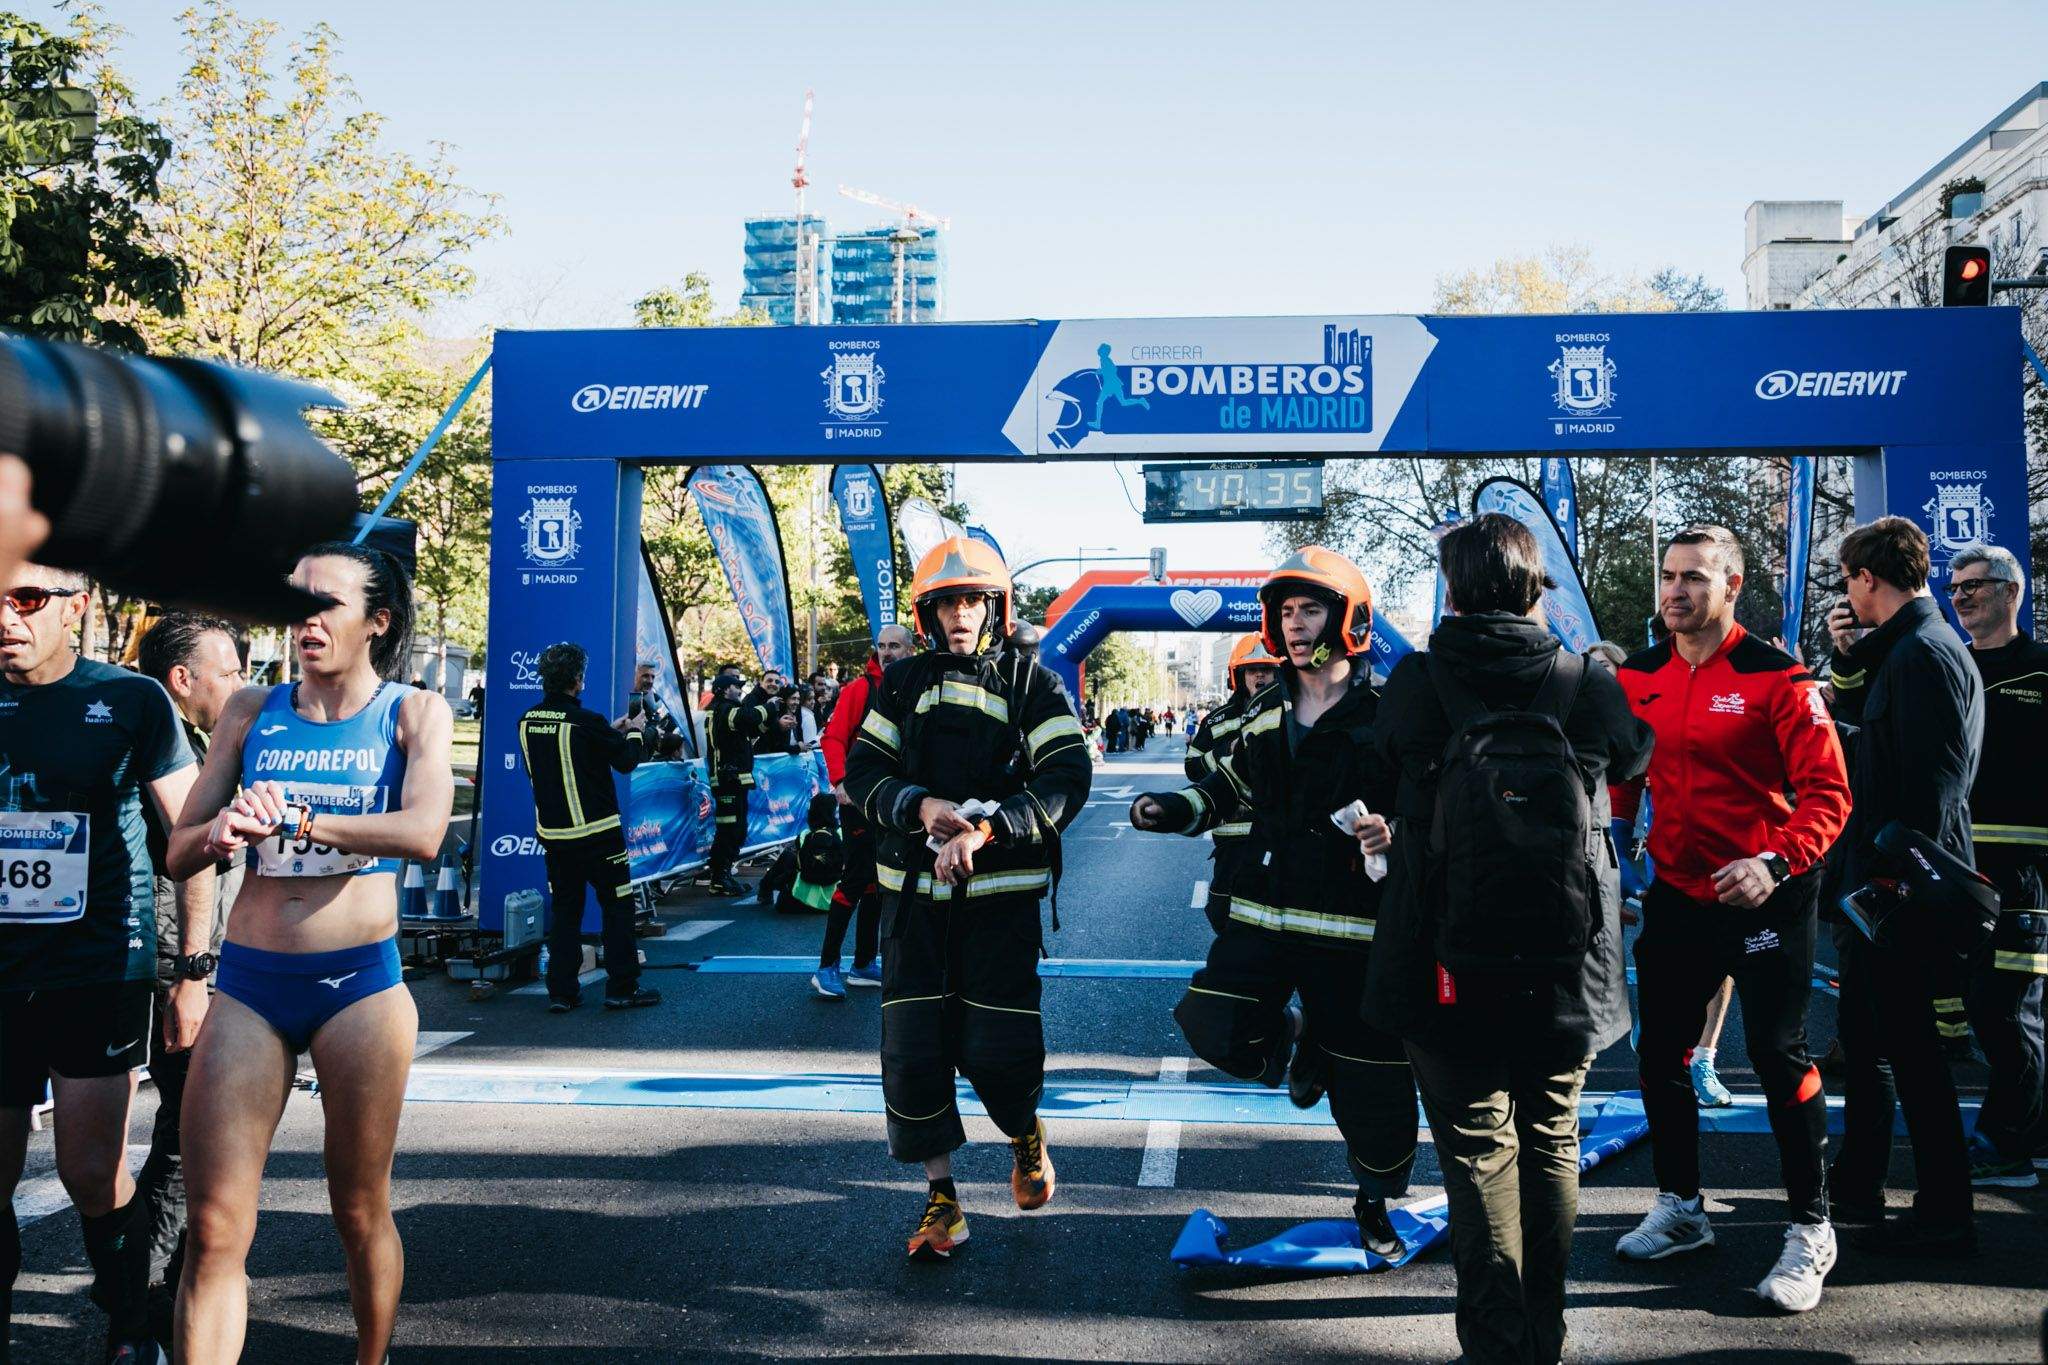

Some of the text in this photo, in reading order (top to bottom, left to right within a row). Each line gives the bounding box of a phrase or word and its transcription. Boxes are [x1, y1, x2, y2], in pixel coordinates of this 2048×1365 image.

[1555, 333, 1610, 342] BOMBEROS
[828, 341, 880, 350] BOMBEROS
[1131, 345, 1202, 360] CARRERA
[1131, 365, 1364, 395] BOMBEROS
[1796, 370, 1907, 397] ENERVIT
[608, 384, 709, 410] ENERVIT
[1219, 397, 1365, 429] de MADRID
[838, 428, 882, 438] MADRID
[1569, 423, 1615, 433] MADRID
[1930, 470, 1988, 480] BOMBEROS
[527, 485, 578, 494] BOMBEROS
[535, 574, 578, 584] MADRID
[1228, 601, 1263, 613] +depo
[1066, 610, 1100, 644] MADRID
[1371, 631, 1391, 653] DRID
[525, 710, 566, 719] BOMBEROS
[528, 725, 557, 734] madrid
[255, 749, 382, 772] CORPOREPOL
[293, 793, 361, 808] BOMBEROS
[0, 860, 51, 889] 68
